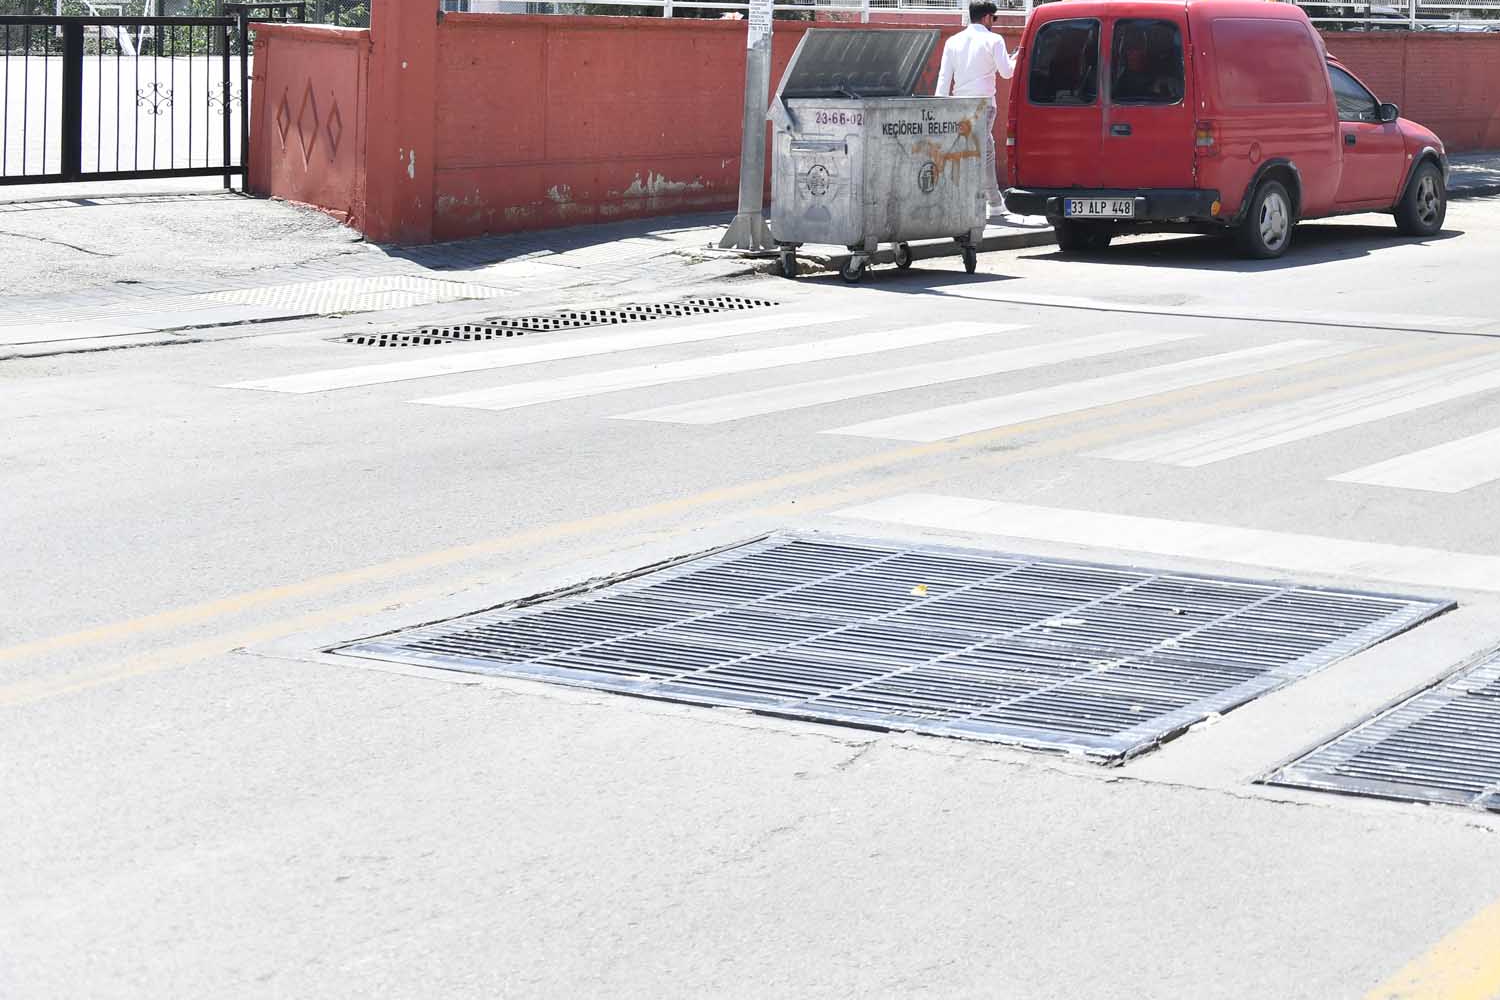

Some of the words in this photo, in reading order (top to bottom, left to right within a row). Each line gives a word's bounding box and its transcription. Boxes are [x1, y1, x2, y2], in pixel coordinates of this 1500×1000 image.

[882, 120, 923, 138] KEÇİÖREN
[1071, 201, 1083, 213] 33
[1088, 201, 1107, 214] ALP
[1112, 201, 1131, 214] 448
